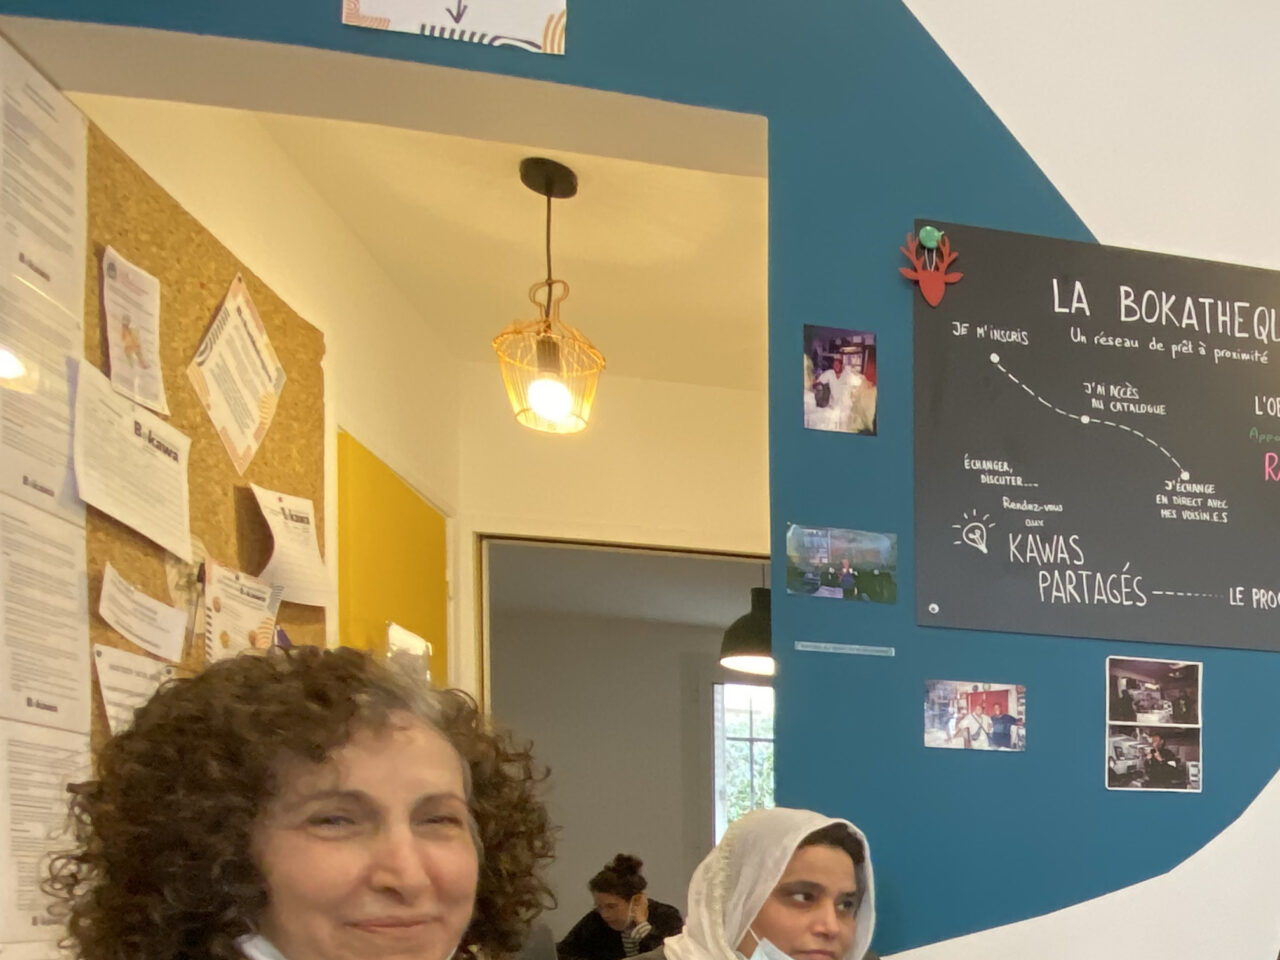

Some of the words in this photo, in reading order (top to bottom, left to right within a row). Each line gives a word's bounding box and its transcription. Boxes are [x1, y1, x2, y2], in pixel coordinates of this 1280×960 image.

[1051, 278, 1091, 316] LA
[952, 321, 970, 336] JE
[1070, 326, 1087, 343] Un
[1094, 331, 1139, 349] réseau
[1149, 336, 1166, 352] de
[1171, 339, 1193, 358] prêt
[1198, 341, 1207, 356] à
[1213, 347, 1269, 365] proximité
[1110, 381, 1140, 399] ACCÈS
[1109, 401, 1167, 415] CATALOGUE
[133, 419, 180, 463] Bkawa
[963, 453, 1014, 472] ÉCHANGER,
[1164, 478, 1216, 494] J'ÉCHANGE
[1001, 496, 1064, 512] Rendez-vous
[1155, 494, 1169, 505] EN
[1207, 496, 1229, 509] AVEC
[1160, 508, 1177, 519] MES
[1008, 533, 1085, 566] KAWAS
[1038, 561, 1148, 607] PARTAGÉS
[1229, 586, 1245, 606] LE
